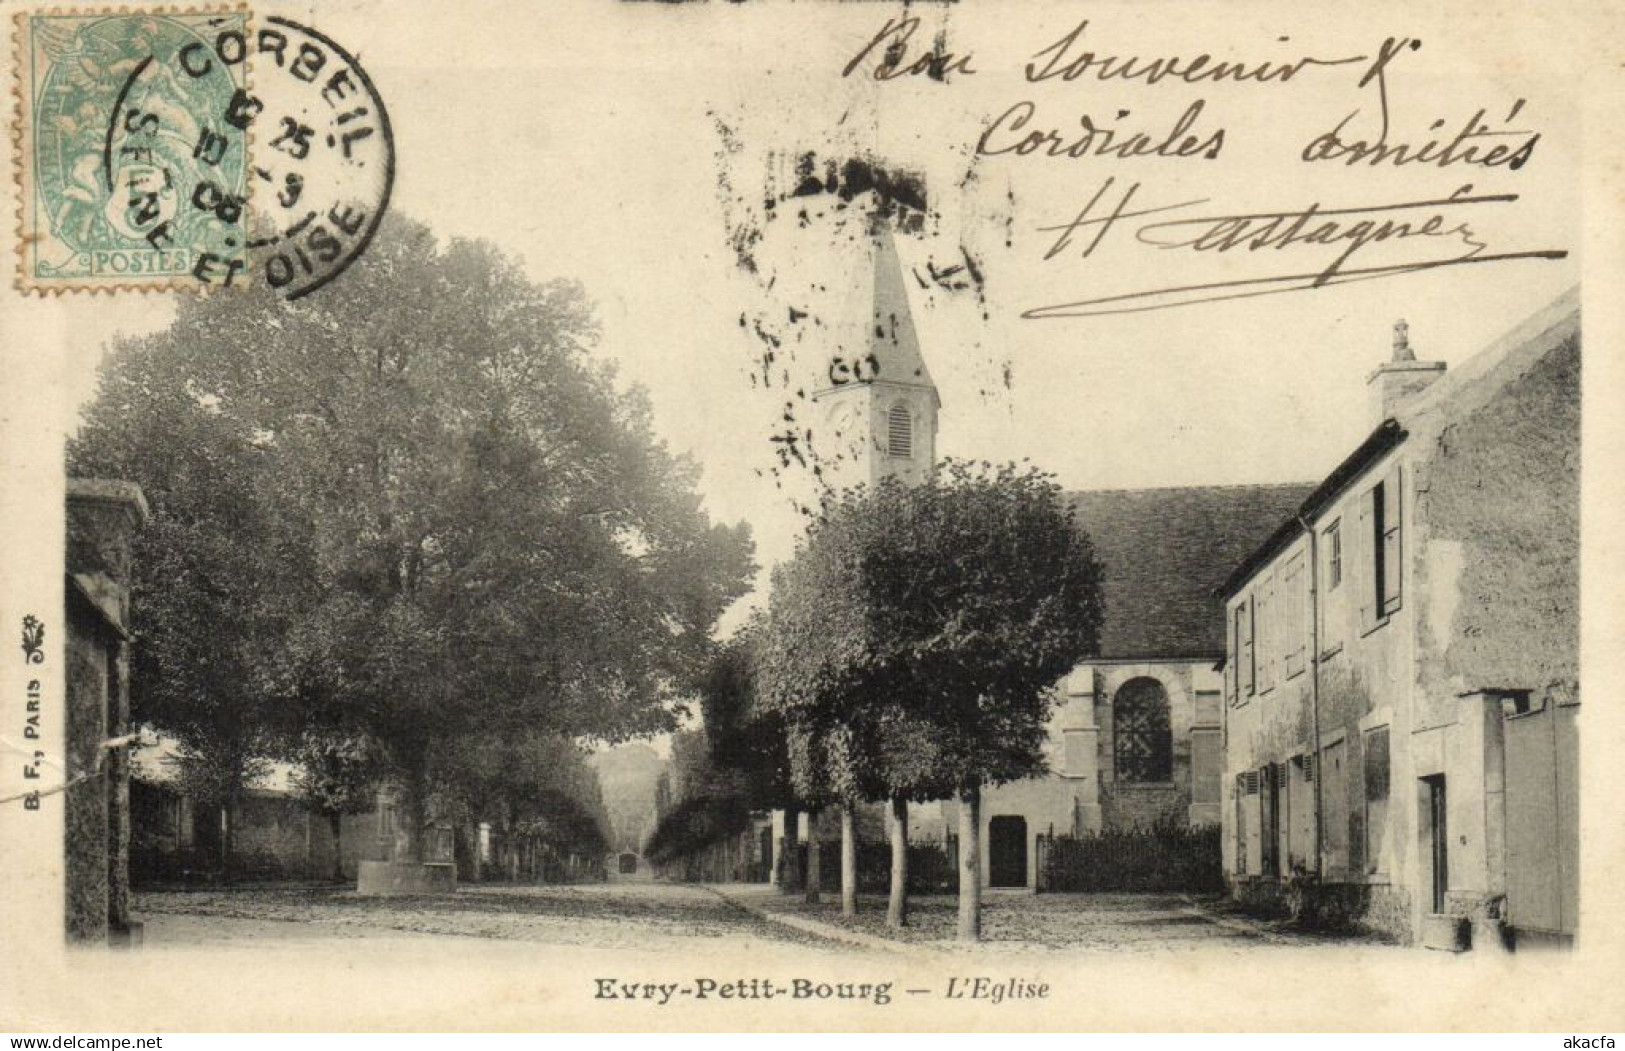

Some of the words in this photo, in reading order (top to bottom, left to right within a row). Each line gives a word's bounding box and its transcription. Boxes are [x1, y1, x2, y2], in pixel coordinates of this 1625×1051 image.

[1025, 20, 1366, 85] Souvenir
[178, 28, 375, 159] CORBEIL
[976, 99, 1226, 160] Cordiales
[96, 251, 187, 274] POSTES
[193, 253, 244, 287] ET
[265, 203, 366, 288] OISE
[594, 977, 894, 1005] Evry-Petit-Bourg
[946, 976, 1050, 1004] L'Eglise
